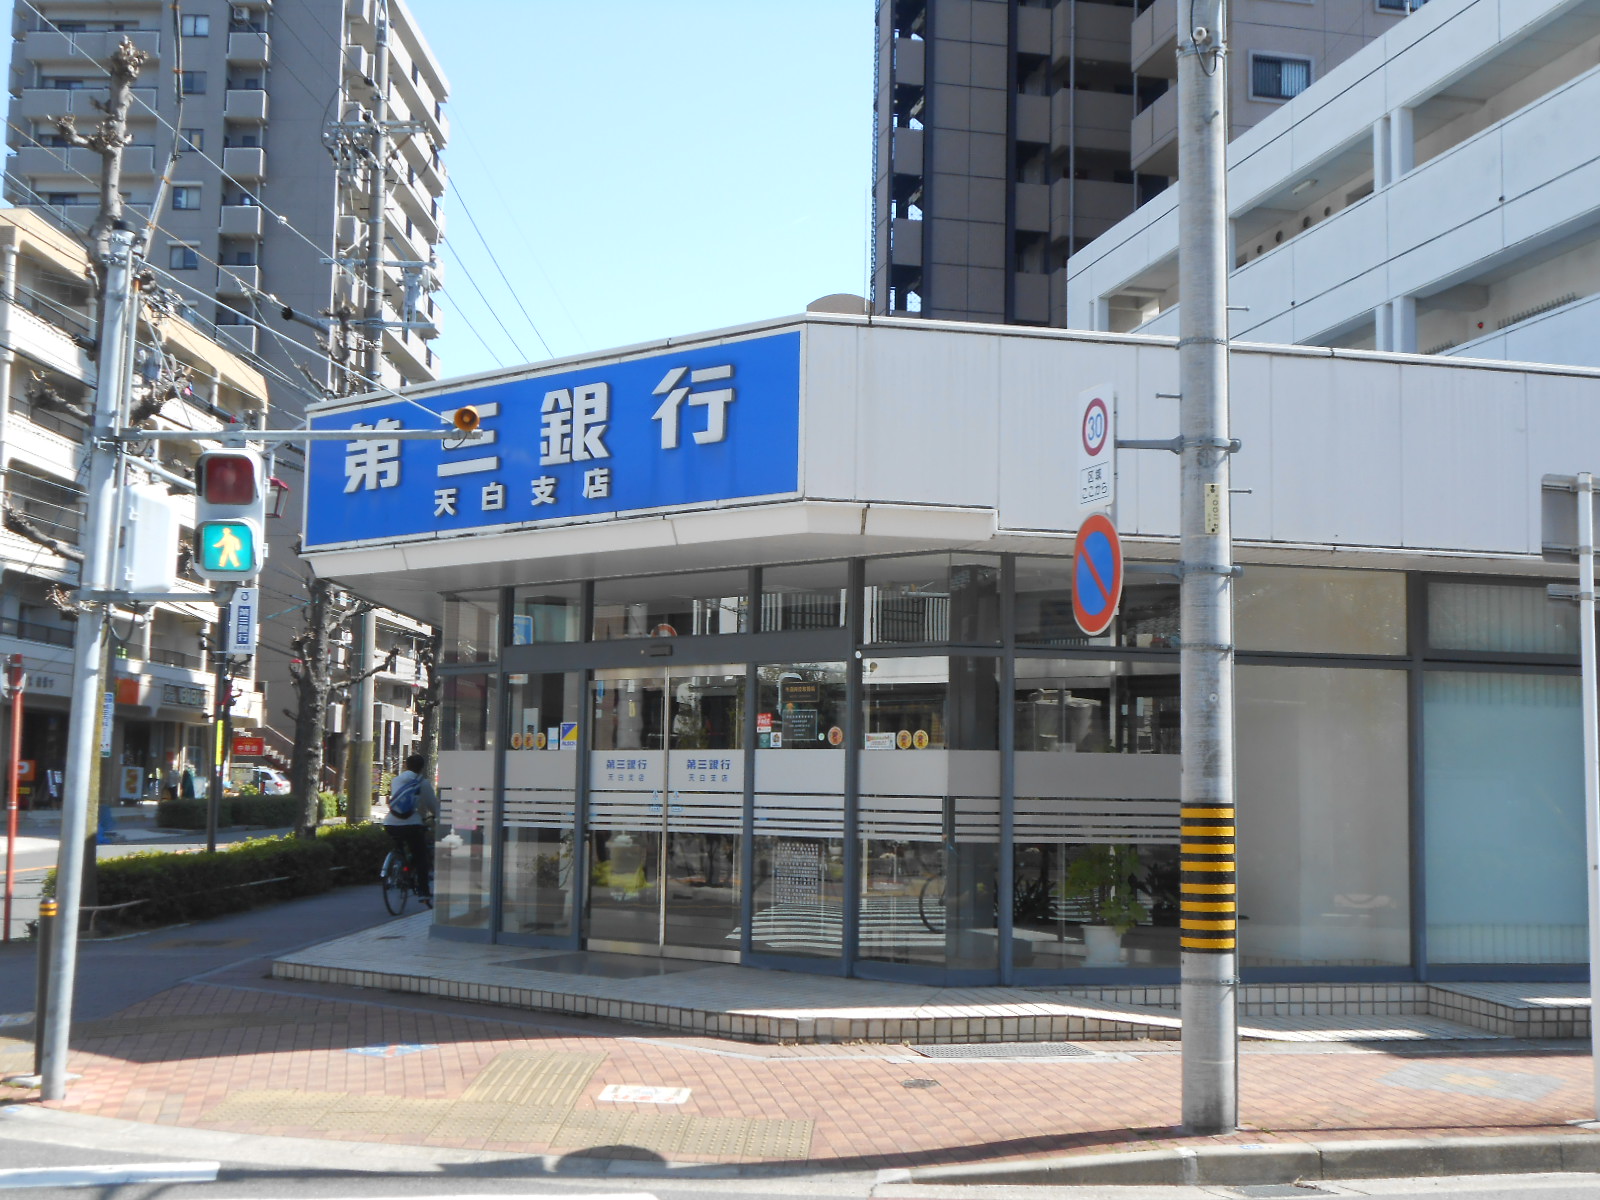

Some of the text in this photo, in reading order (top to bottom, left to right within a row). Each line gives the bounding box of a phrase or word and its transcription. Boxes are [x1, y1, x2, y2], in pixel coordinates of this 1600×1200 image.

[343, 364, 735, 494] 第三銀行
[1087, 413, 1102, 441] 30
[433, 468, 611, 518] 天白支店
[606, 759, 648, 770] 第三銀行
[687, 759, 731, 770] 第三銀行
